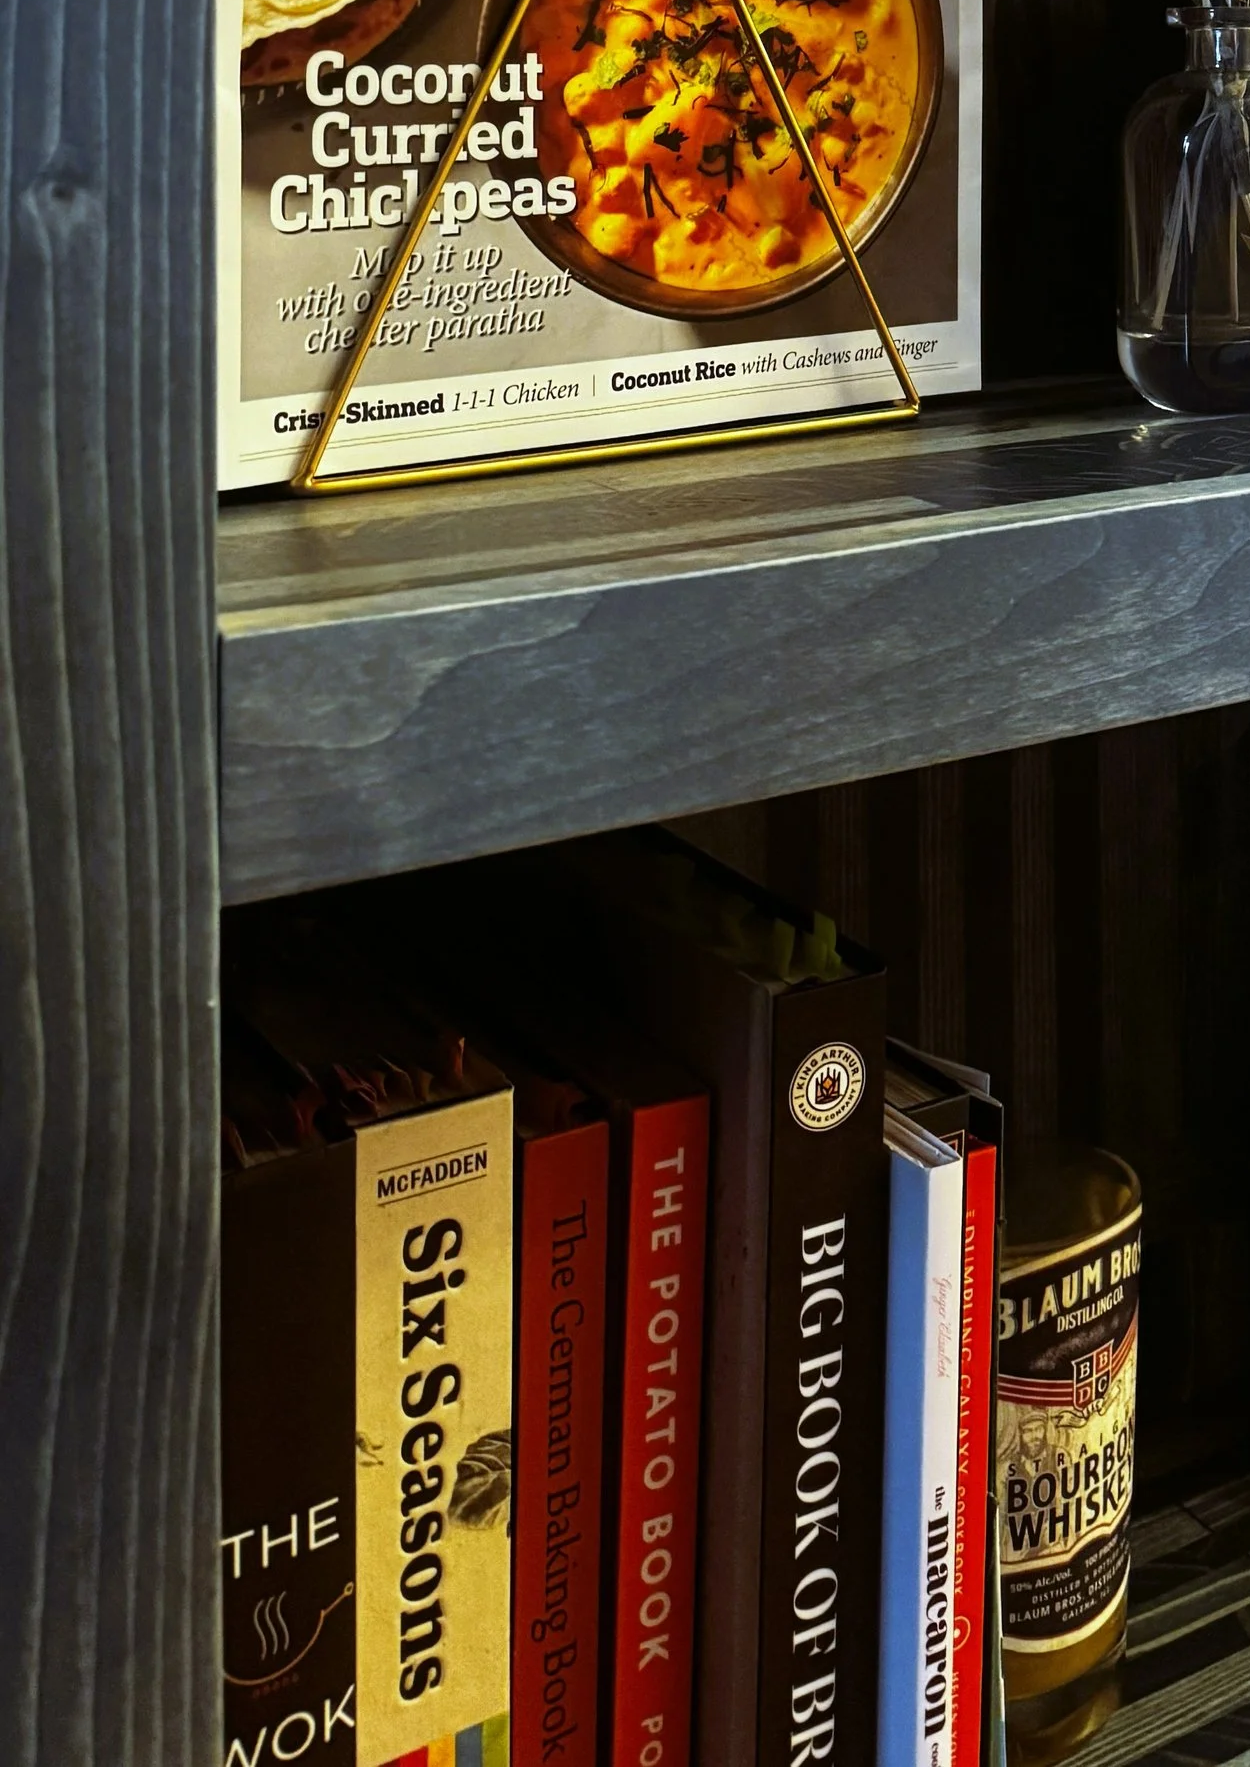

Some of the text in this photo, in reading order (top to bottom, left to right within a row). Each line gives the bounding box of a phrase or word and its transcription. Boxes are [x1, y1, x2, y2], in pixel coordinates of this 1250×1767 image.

[305, 49, 543, 107] Coconut
[349, 243, 503, 284] Mp it up
[276, 267, 573, 321] with oe-ingredient
[304, 302, 545, 353] cheter paratha
[611, 365, 691, 393] Coconut
[695, 360, 736, 381] Rice
[741, 356, 778, 376] with
[782, 346, 851, 372] Cashews
[854, 343, 884, 361] and
[452, 390, 497, 412] 1-1-1
[503, 379, 580, 407] Chicken
[796, 1049, 859, 1090] KING ARTHUR
[798, 1088, 857, 1123] BAKING COMPANY
[651, 1147, 685, 1252] THE
[931, 1274, 953, 1318] Ginger
[998, 1257, 1103, 1341] BLAUM
[1057, 1294, 1113, 1333] DISTILLING
[642, 1273, 681, 1491] POTATO
[1078, 1375, 1108, 1404] D C
[1079, 1351, 1108, 1380] B B
[399, 1217, 468, 1703] Six Seasons
[1007, 1416, 1134, 1514] BOURBON
[1008, 1403, 1130, 1477] STRAIG
[530, 1199, 588, 1763] The German Baking Book
[790, 1212, 846, 1767] BIG BOOK OF BR
[934, 1485, 946, 1511] the
[220, 1497, 340, 1579] THE
[638, 1514, 673, 1672] BOOK
[1009, 1592, 1085, 1624] BLAUM BROS.
[1032, 1579, 1081, 1604] DISTILLED
[925, 1512, 951, 1740] macaron
